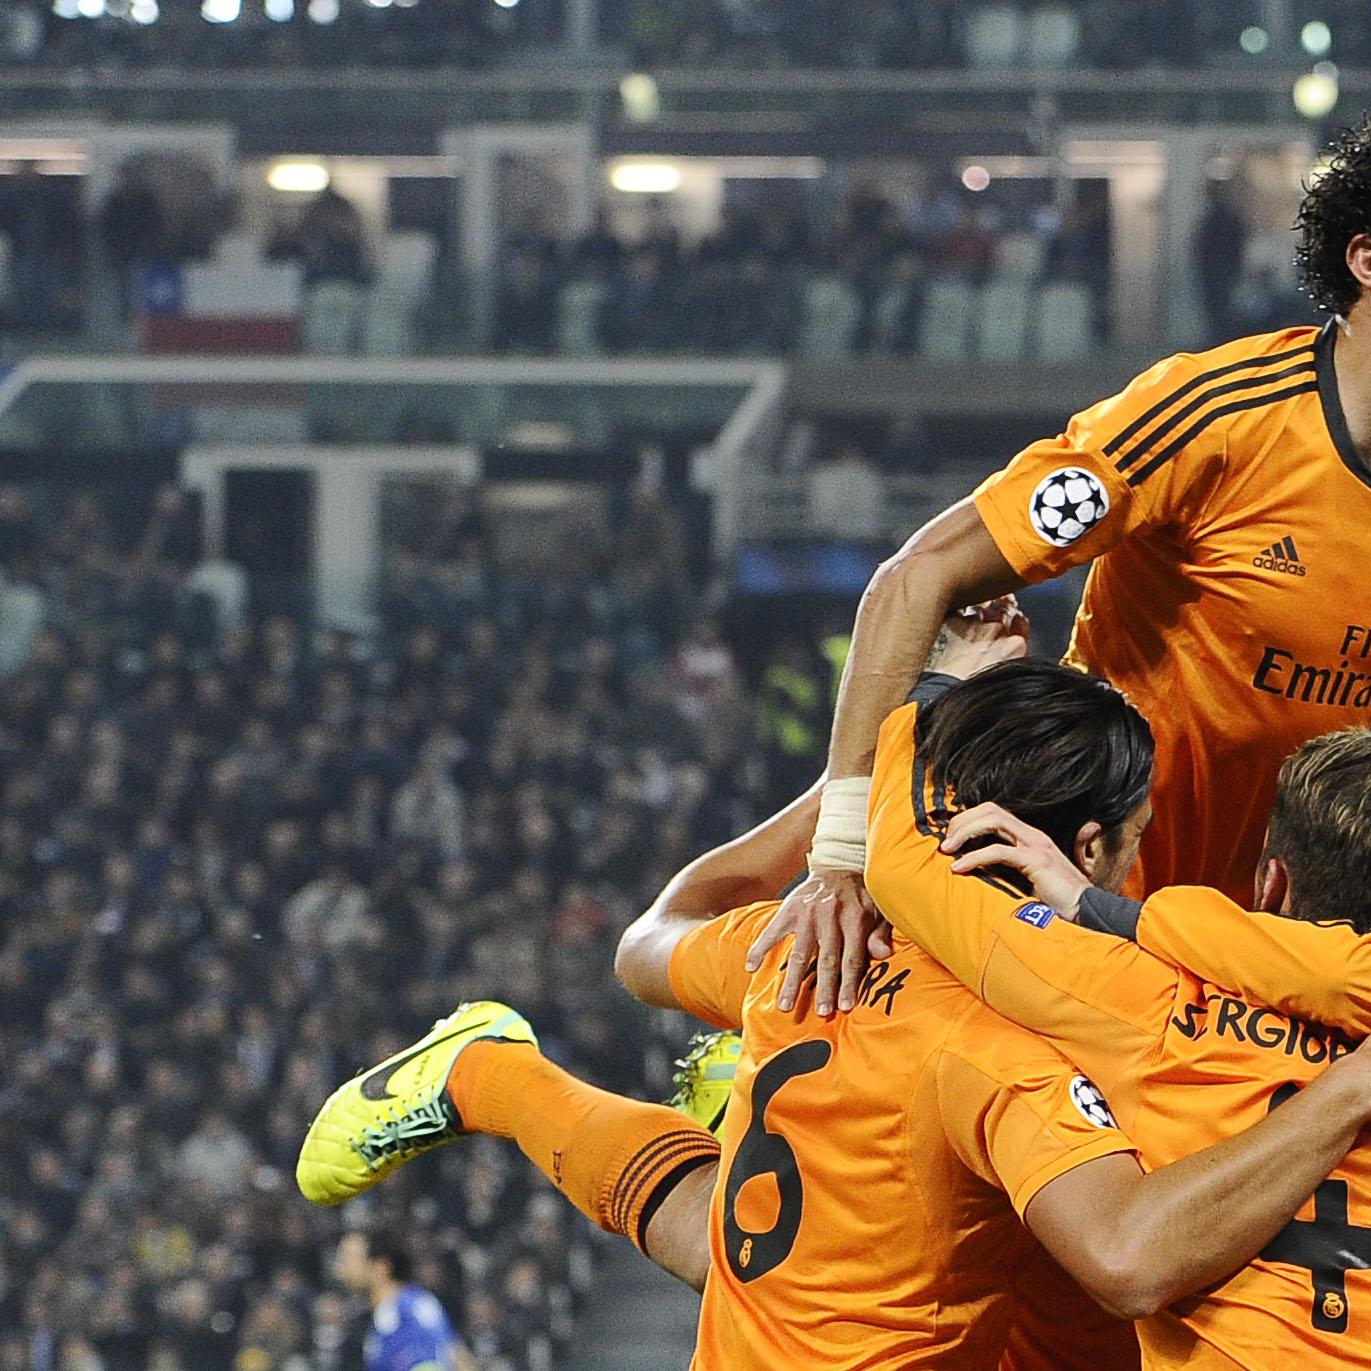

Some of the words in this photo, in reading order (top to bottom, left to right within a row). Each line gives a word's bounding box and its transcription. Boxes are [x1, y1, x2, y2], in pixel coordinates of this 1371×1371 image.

[1252, 556, 1306, 576] adidas
[1172, 994, 1328, 1064] SRGIO
[724, 1039, 832, 1284] 6
